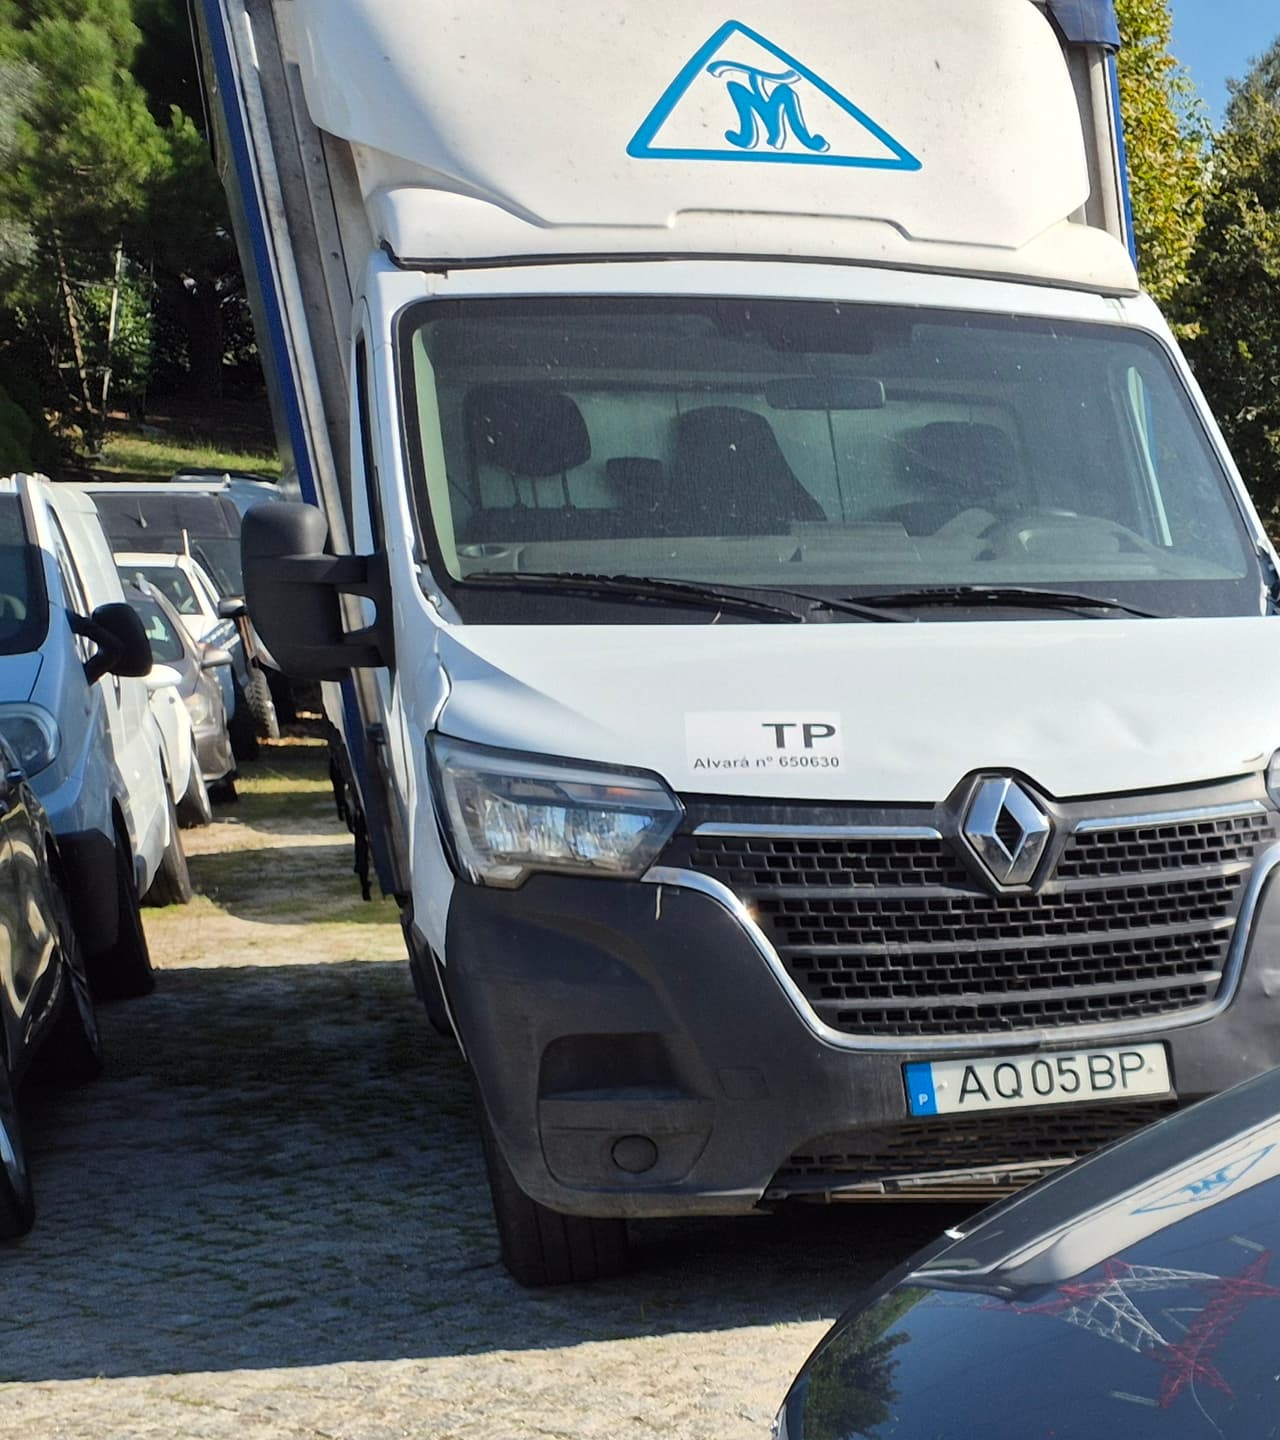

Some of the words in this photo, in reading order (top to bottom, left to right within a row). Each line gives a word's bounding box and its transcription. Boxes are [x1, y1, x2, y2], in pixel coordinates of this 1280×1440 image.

[762, 723, 836, 749] TP
[693, 756, 750, 769] Alvará
[779, 756, 840, 768] 650630
